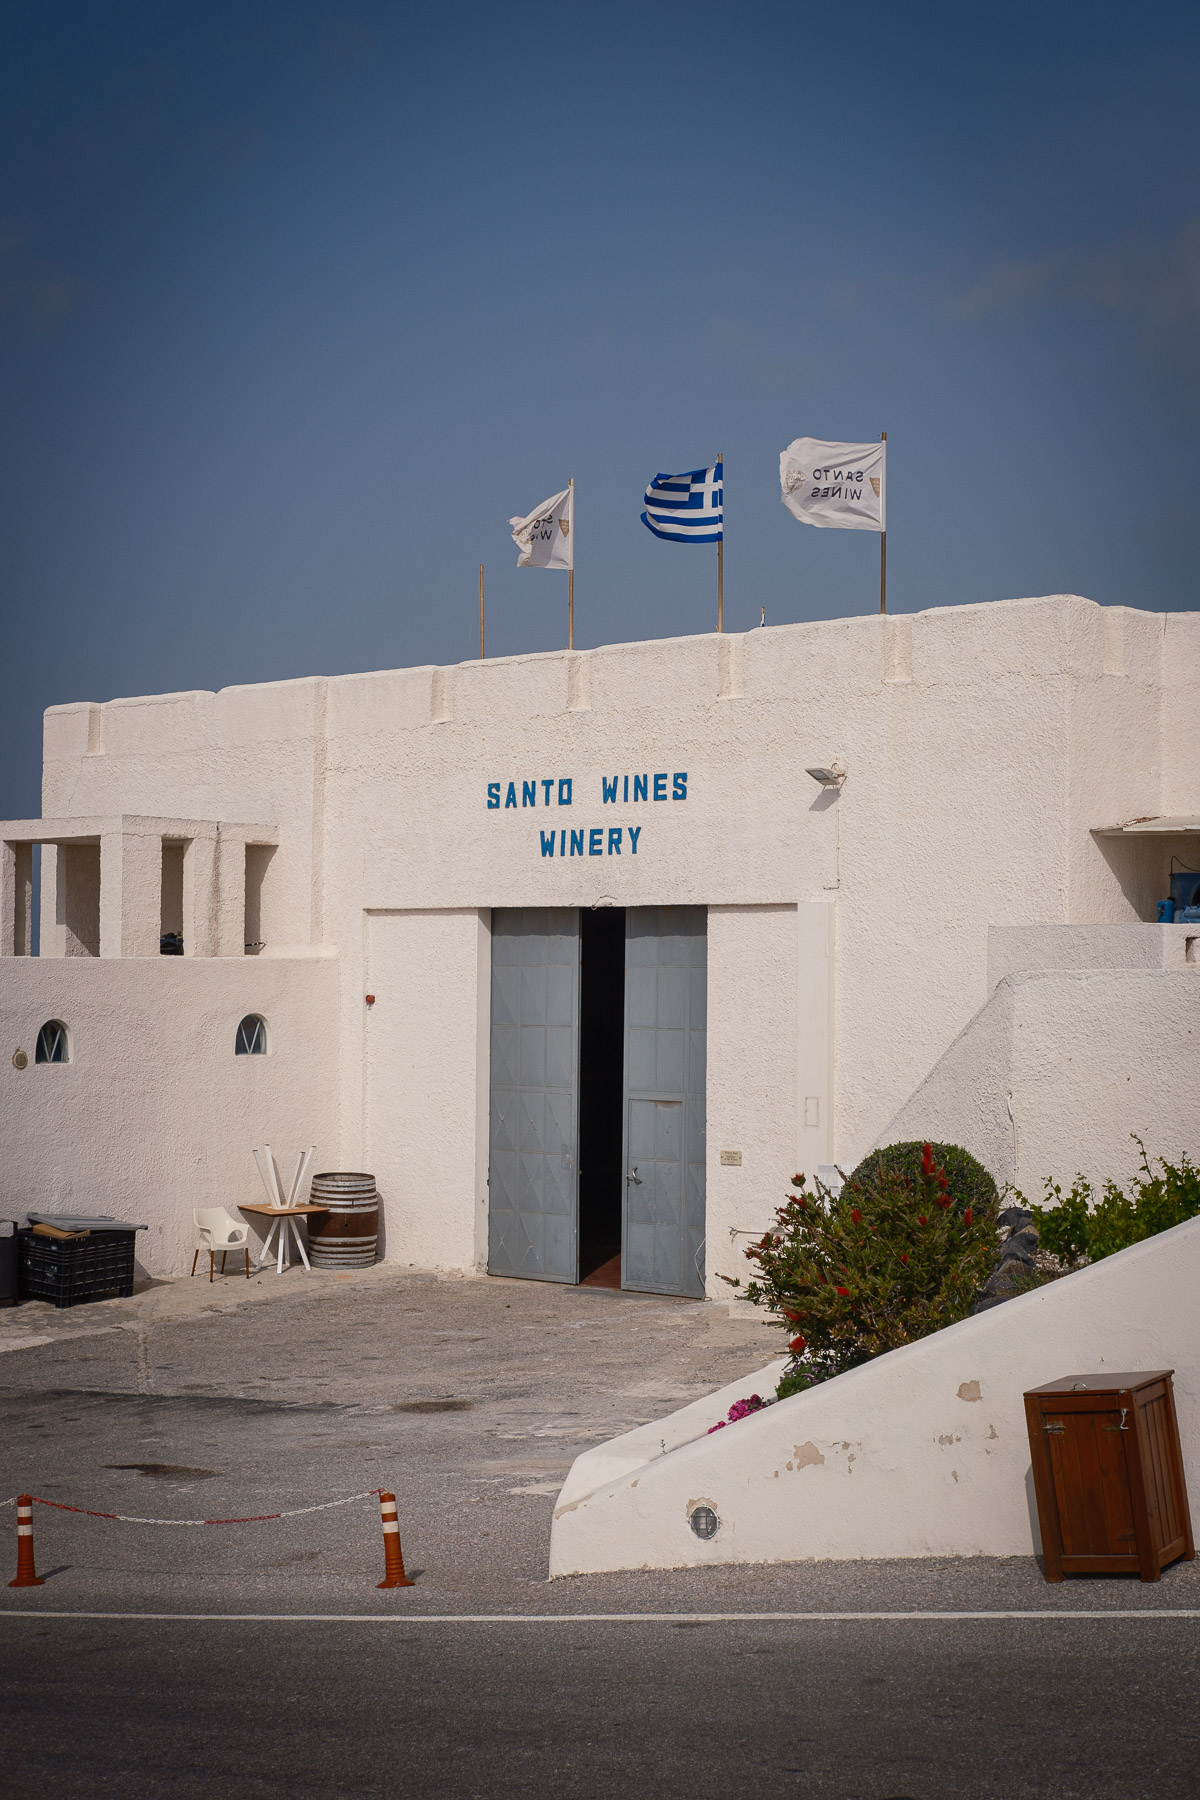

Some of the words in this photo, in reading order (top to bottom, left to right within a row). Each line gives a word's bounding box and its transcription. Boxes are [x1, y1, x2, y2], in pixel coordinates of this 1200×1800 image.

[487, 778, 573, 809] SANTO
[602, 772, 688, 804] WINES
[539, 826, 642, 857] WINERY
